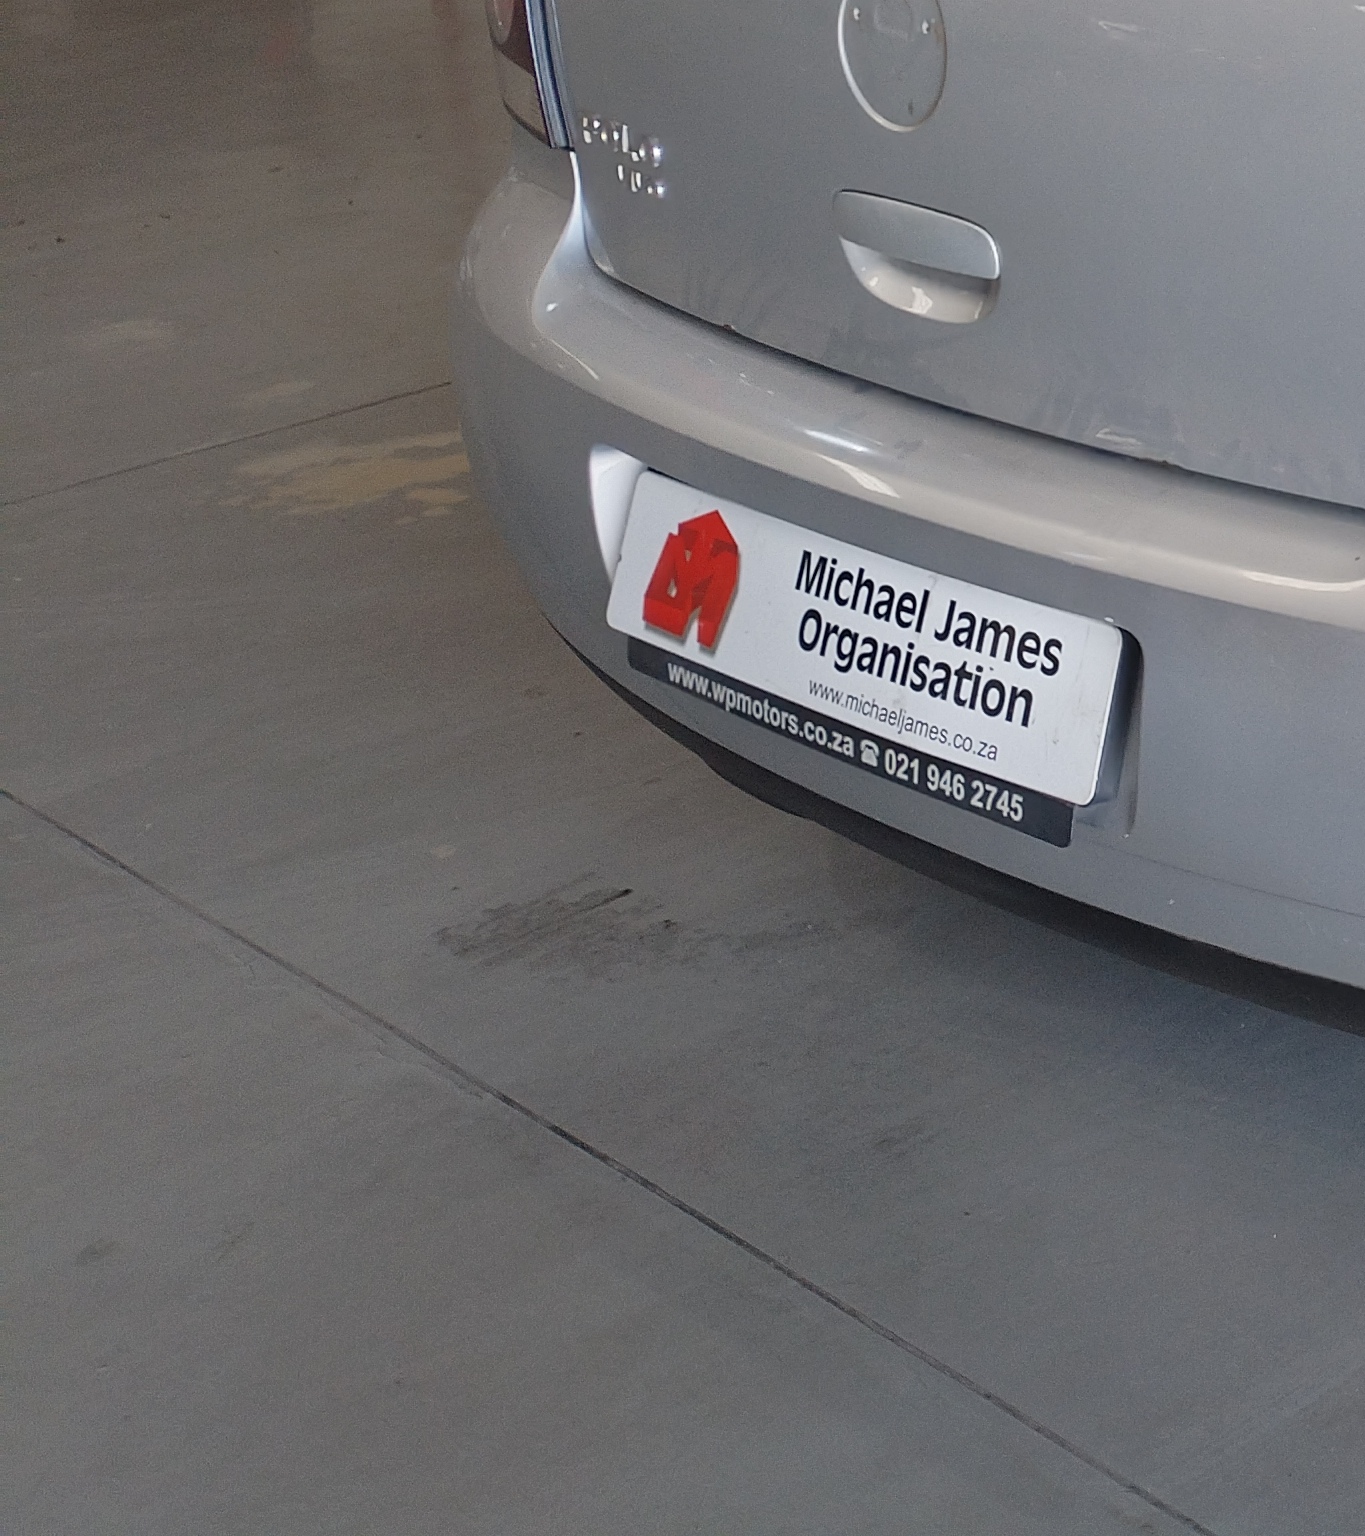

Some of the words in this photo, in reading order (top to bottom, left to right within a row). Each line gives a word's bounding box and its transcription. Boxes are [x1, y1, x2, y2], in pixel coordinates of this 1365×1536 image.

[794, 549, 930, 633] Michael
[934, 598, 1063, 677] James
[798, 609, 1035, 728] Organisation
[667, 662, 855, 758] www.wpmotors.co.za
[884, 751, 920, 785] 021
[926, 764, 965, 801] 946
[971, 780, 1024, 822] 2745
[808, 678, 998, 762] www.michaeljames.co.za
